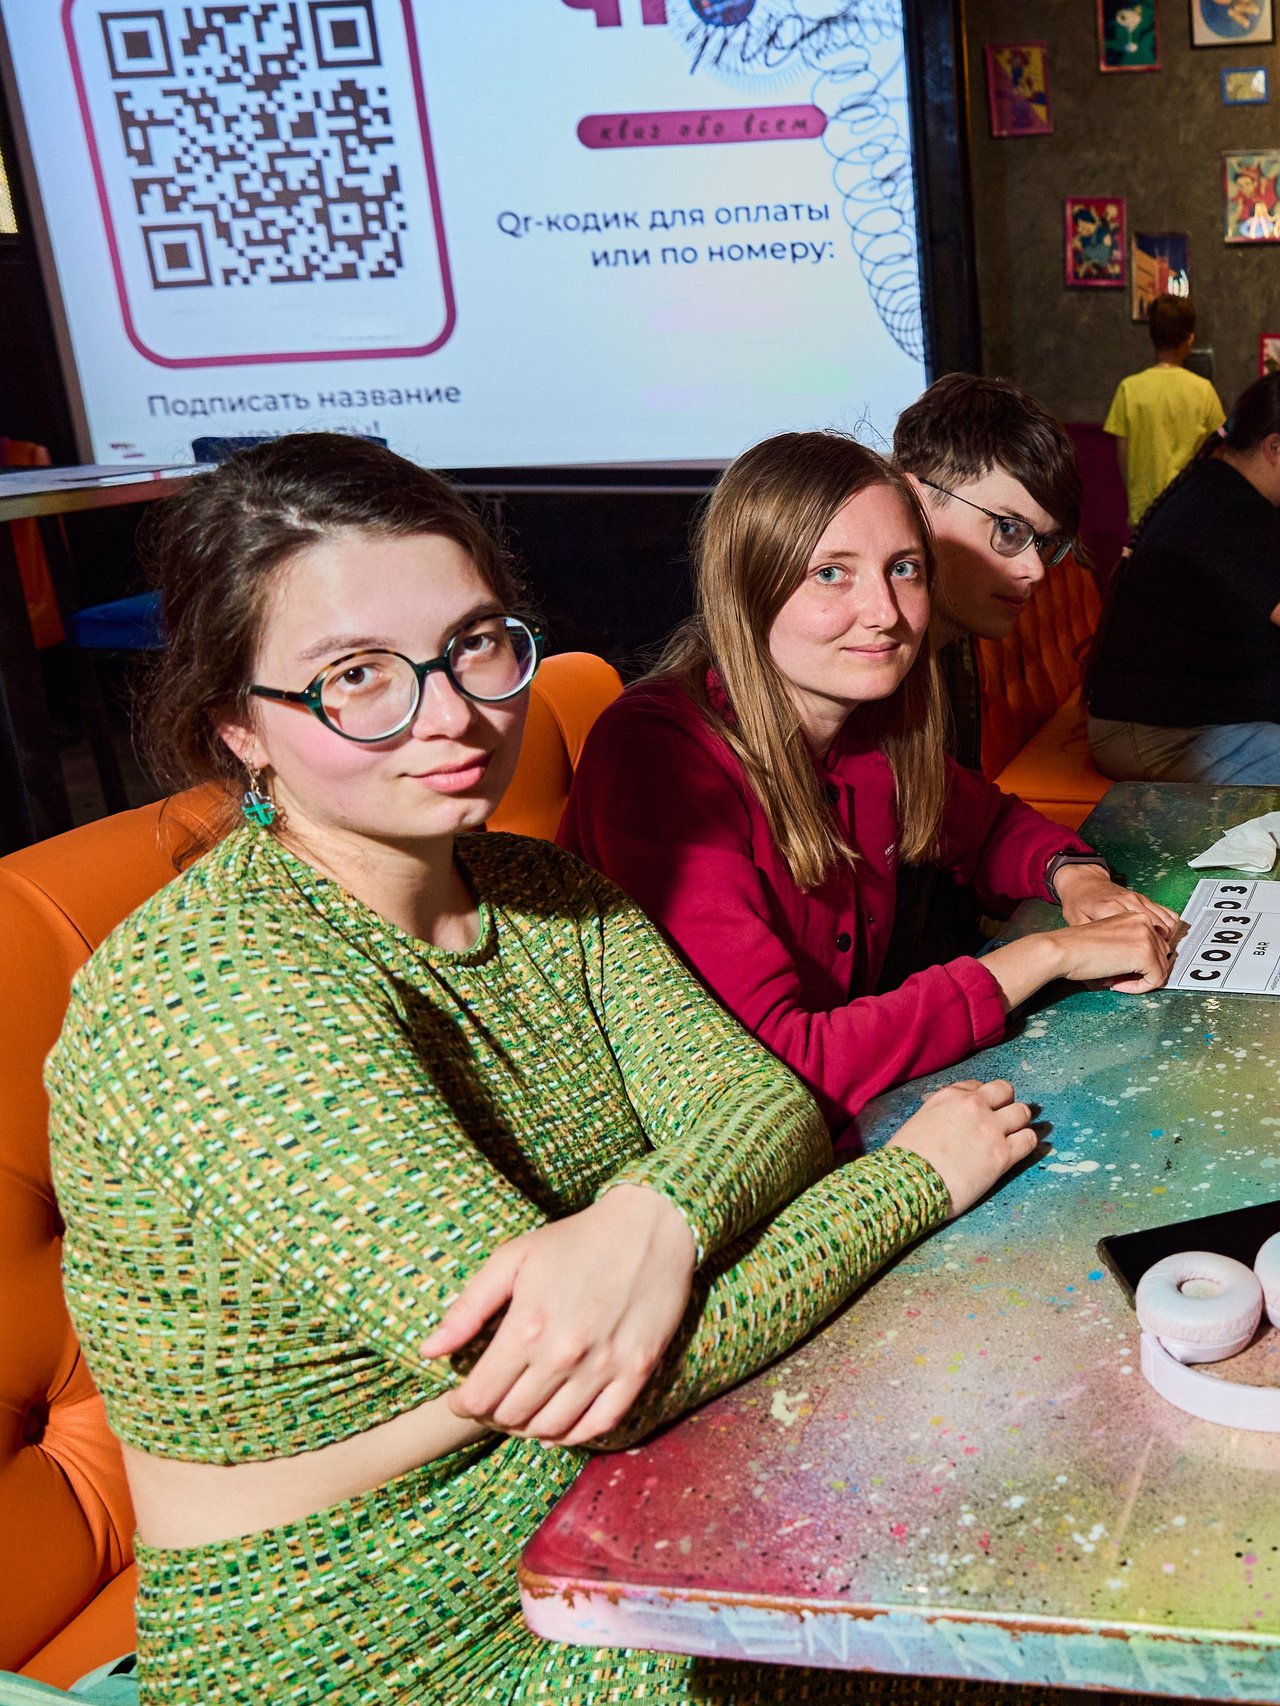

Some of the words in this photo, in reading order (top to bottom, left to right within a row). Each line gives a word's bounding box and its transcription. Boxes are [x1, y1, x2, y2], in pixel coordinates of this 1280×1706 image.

[680, 115, 724, 138] обо
[497, 210, 641, 238] Qr-кодик
[650, 208, 704, 231] для
[714, 203, 830, 223] оплаты
[591, 249, 650, 268] или
[661, 246, 698, 264] по
[708, 240, 835, 264] номеру:
[148, 393, 310, 418] Подписать
[317, 386, 461, 408] название
[1189, 915, 1251, 981] СОЮЗ
